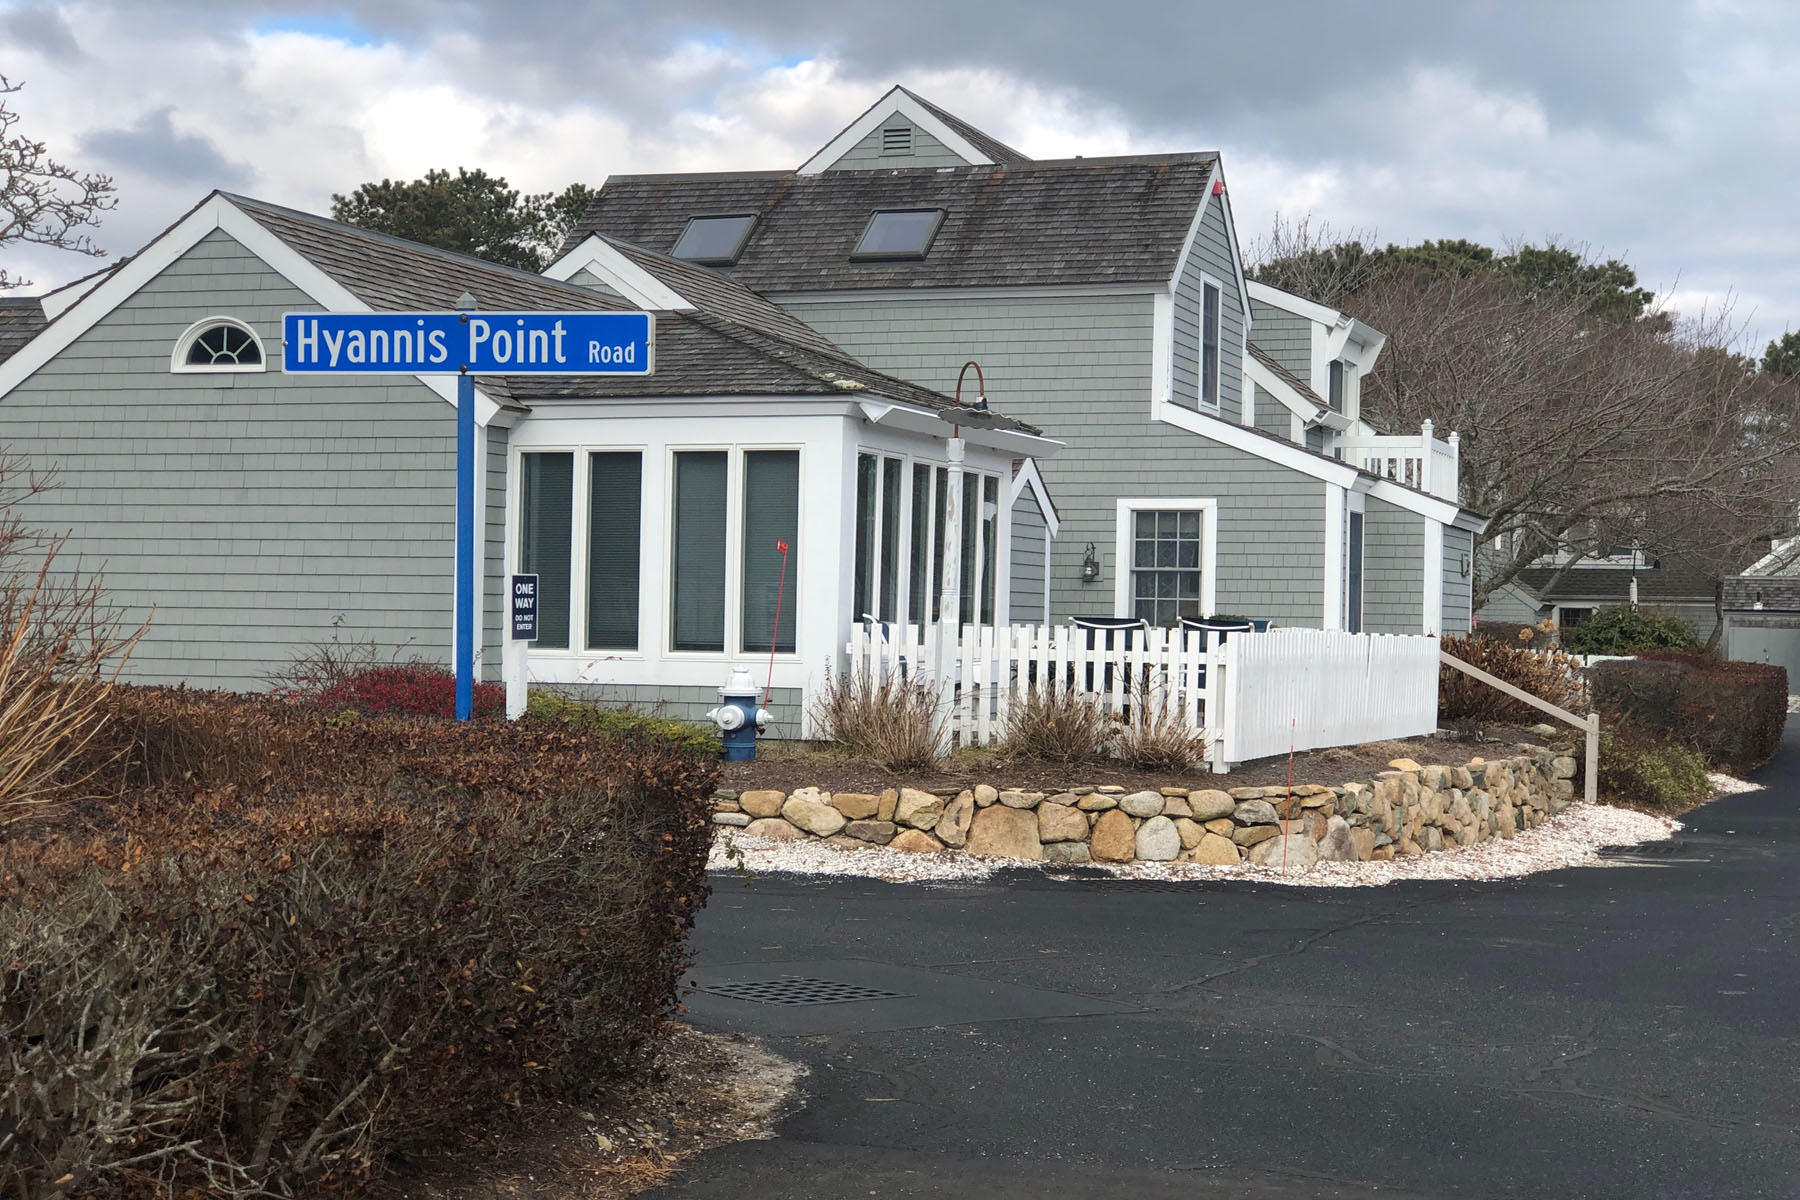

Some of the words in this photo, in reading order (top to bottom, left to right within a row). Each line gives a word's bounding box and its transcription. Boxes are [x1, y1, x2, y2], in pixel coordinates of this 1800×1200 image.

[297, 319, 448, 367] Hyannis
[469, 319, 567, 363] Point
[588, 341, 635, 363] Road
[515, 583, 534, 594] ONE
[515, 597, 534, 609] WAY
